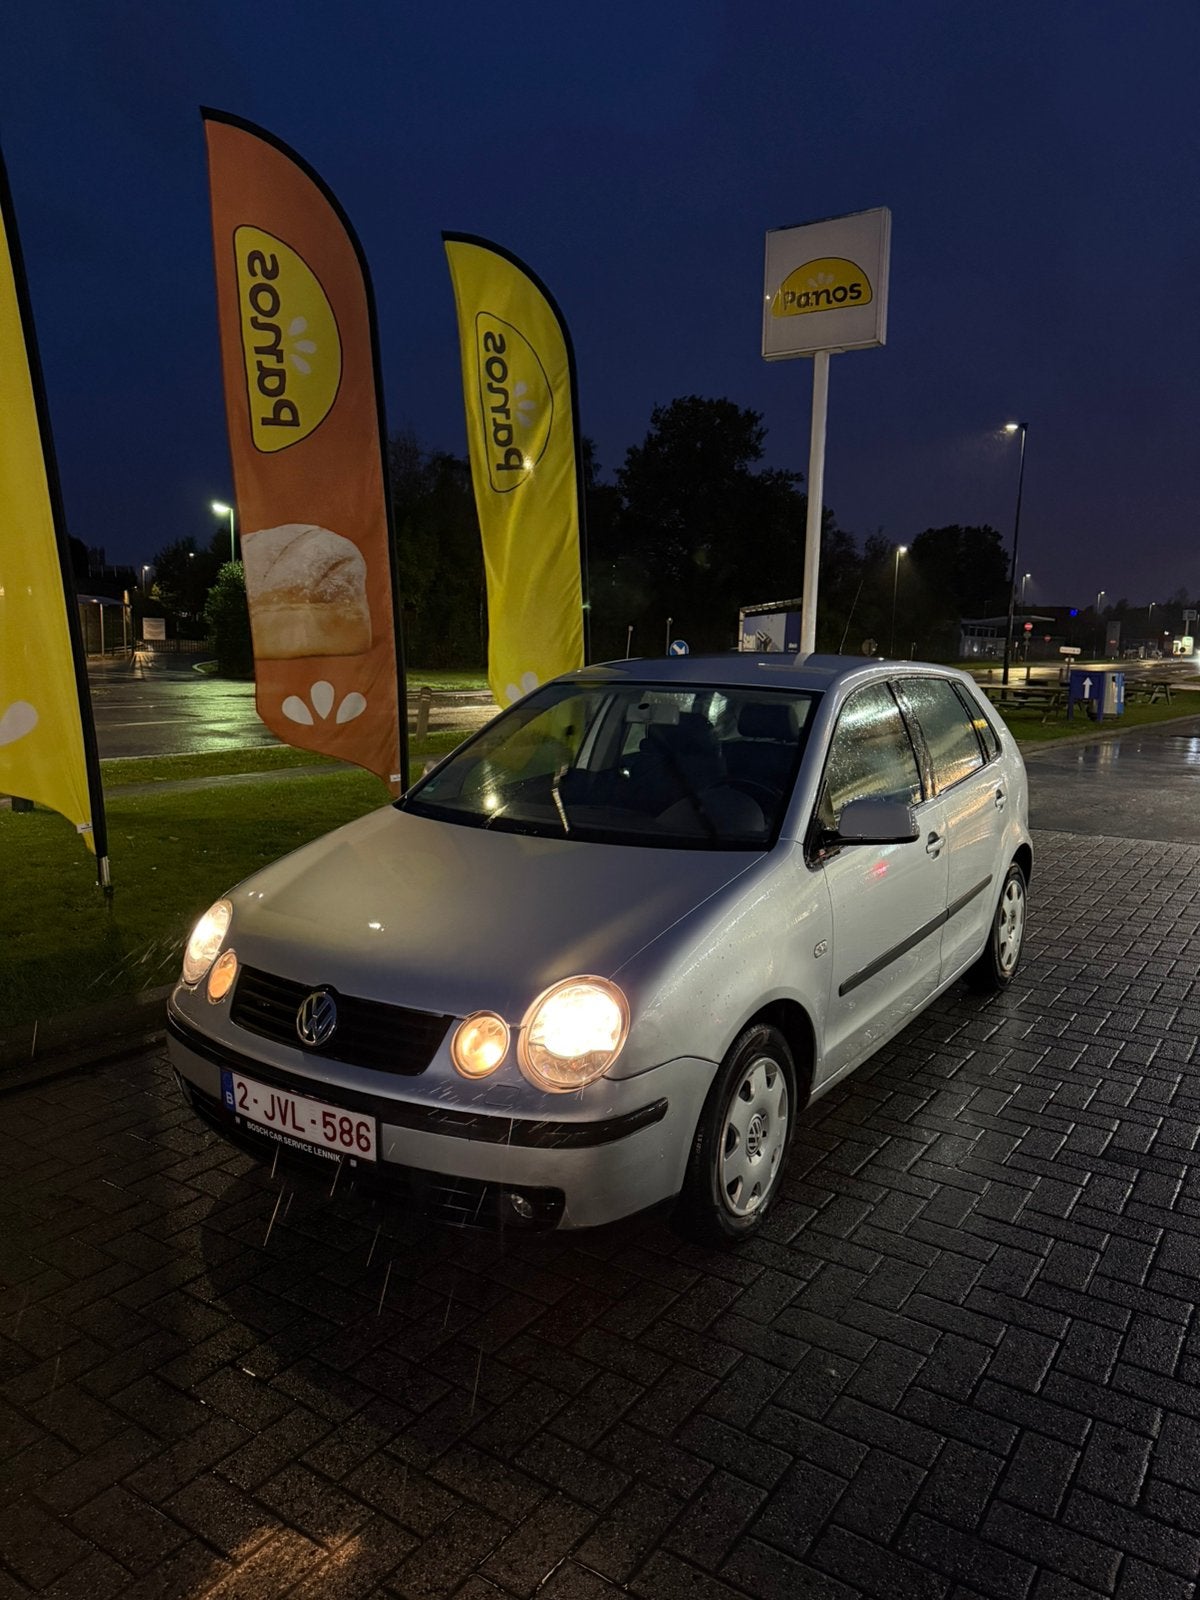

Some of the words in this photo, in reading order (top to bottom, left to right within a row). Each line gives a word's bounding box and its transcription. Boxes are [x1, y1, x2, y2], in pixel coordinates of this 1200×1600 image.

[783, 282, 862, 311] Panos
[226, 1091, 233, 1105] B
[246, 1121, 269, 1137] BOSCH
[269, 1131, 284, 1144] CAR
[283, 1136, 313, 1154] SERVICE
[313, 1146, 342, 1163] LENNIK
